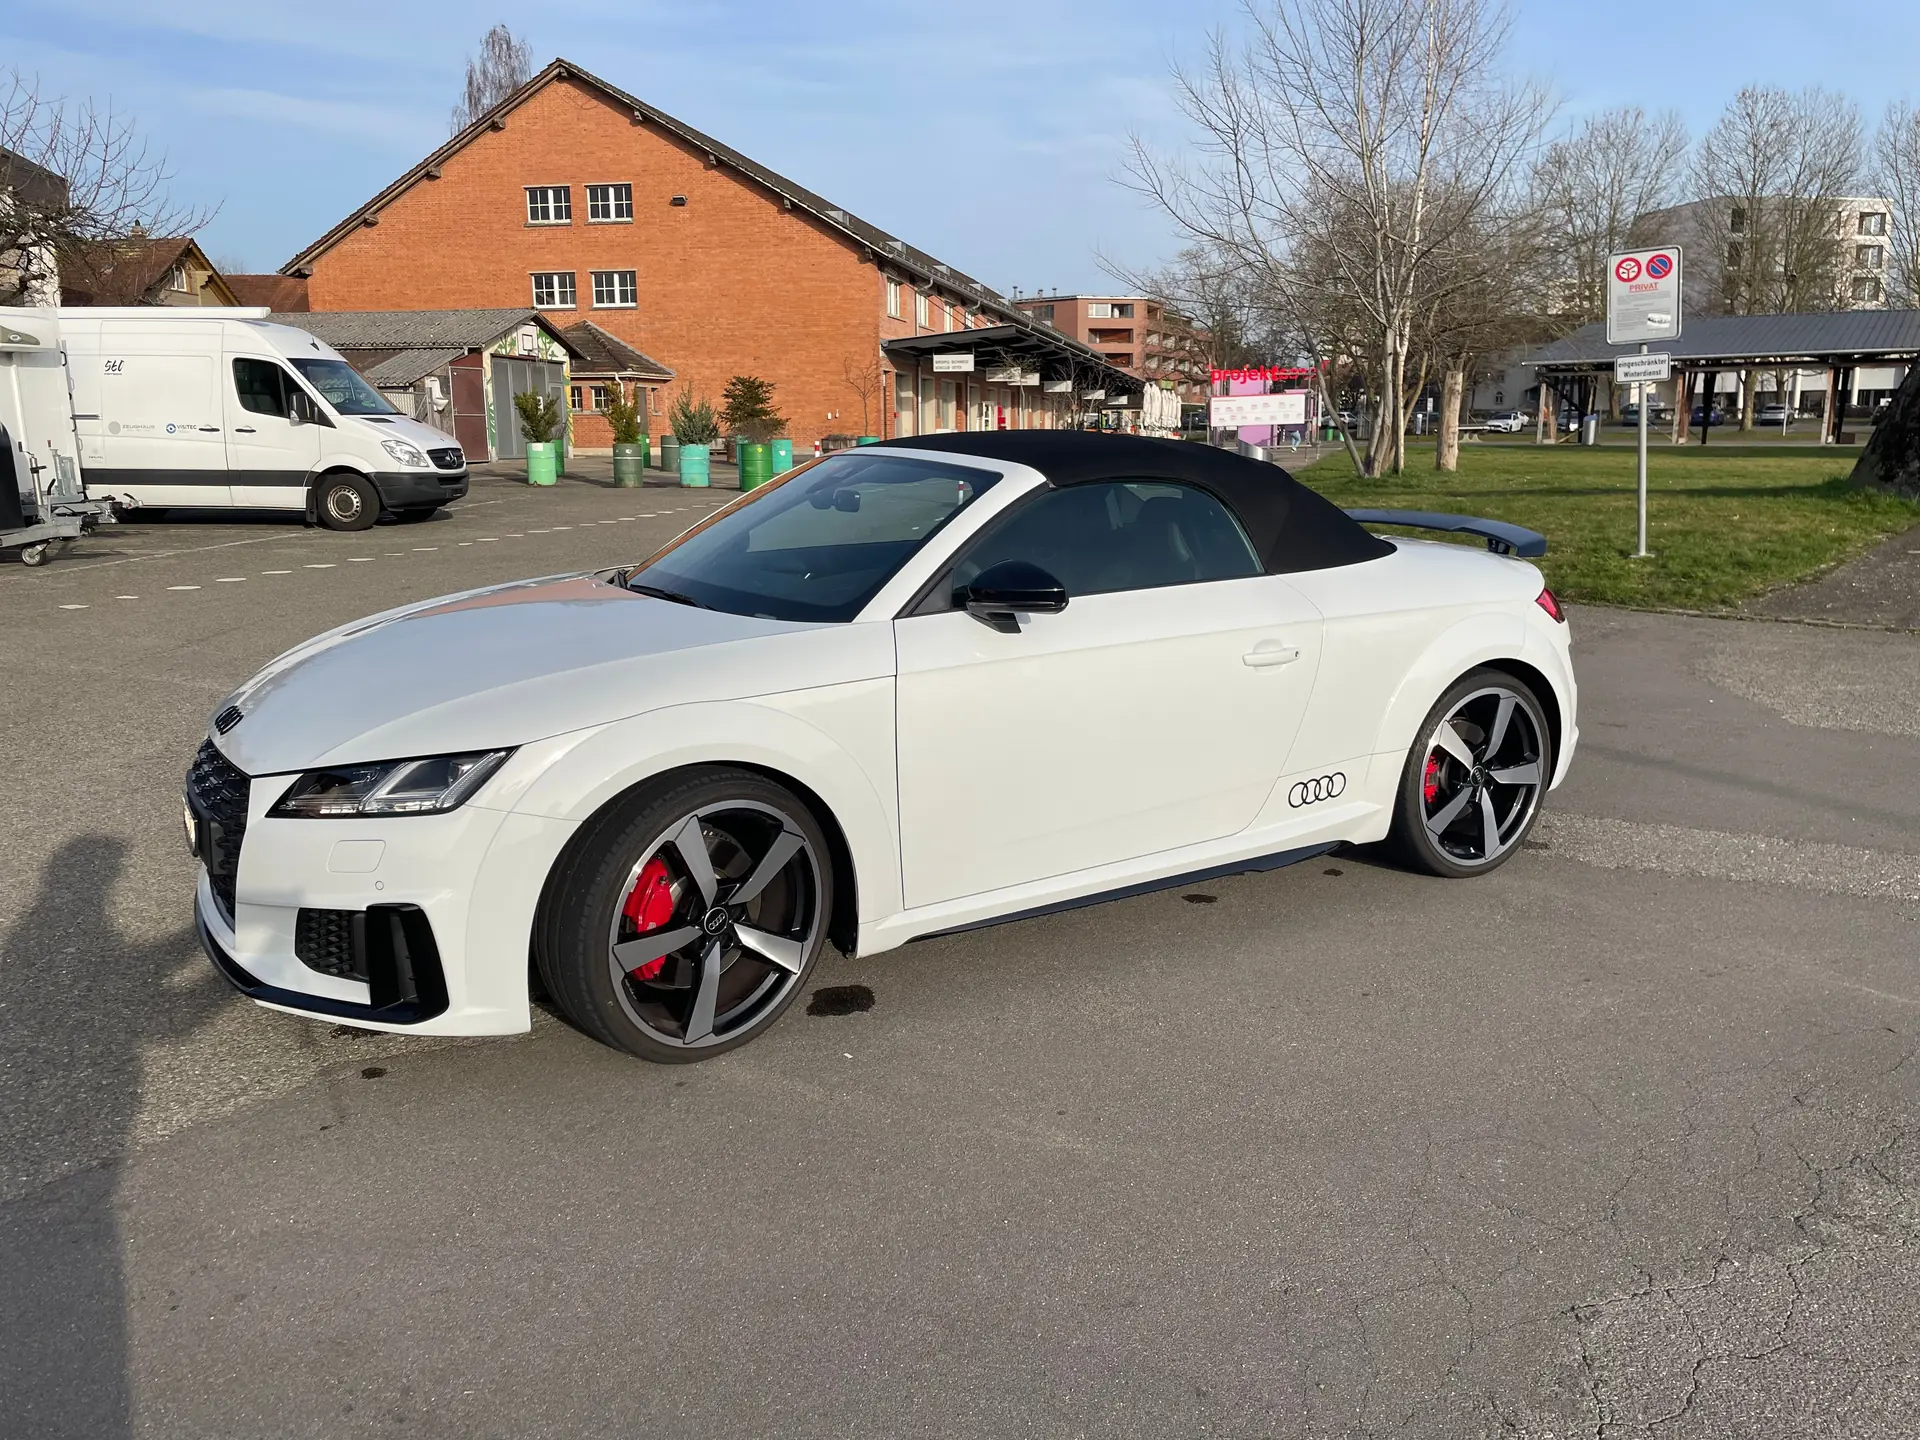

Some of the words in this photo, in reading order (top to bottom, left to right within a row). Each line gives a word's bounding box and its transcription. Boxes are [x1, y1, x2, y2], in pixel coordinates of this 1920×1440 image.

[1629, 282, 1658, 291] PRIVAT
[1618, 358, 1667, 369] eingeschränkter
[1623, 369, 1662, 378] Winterdienst
